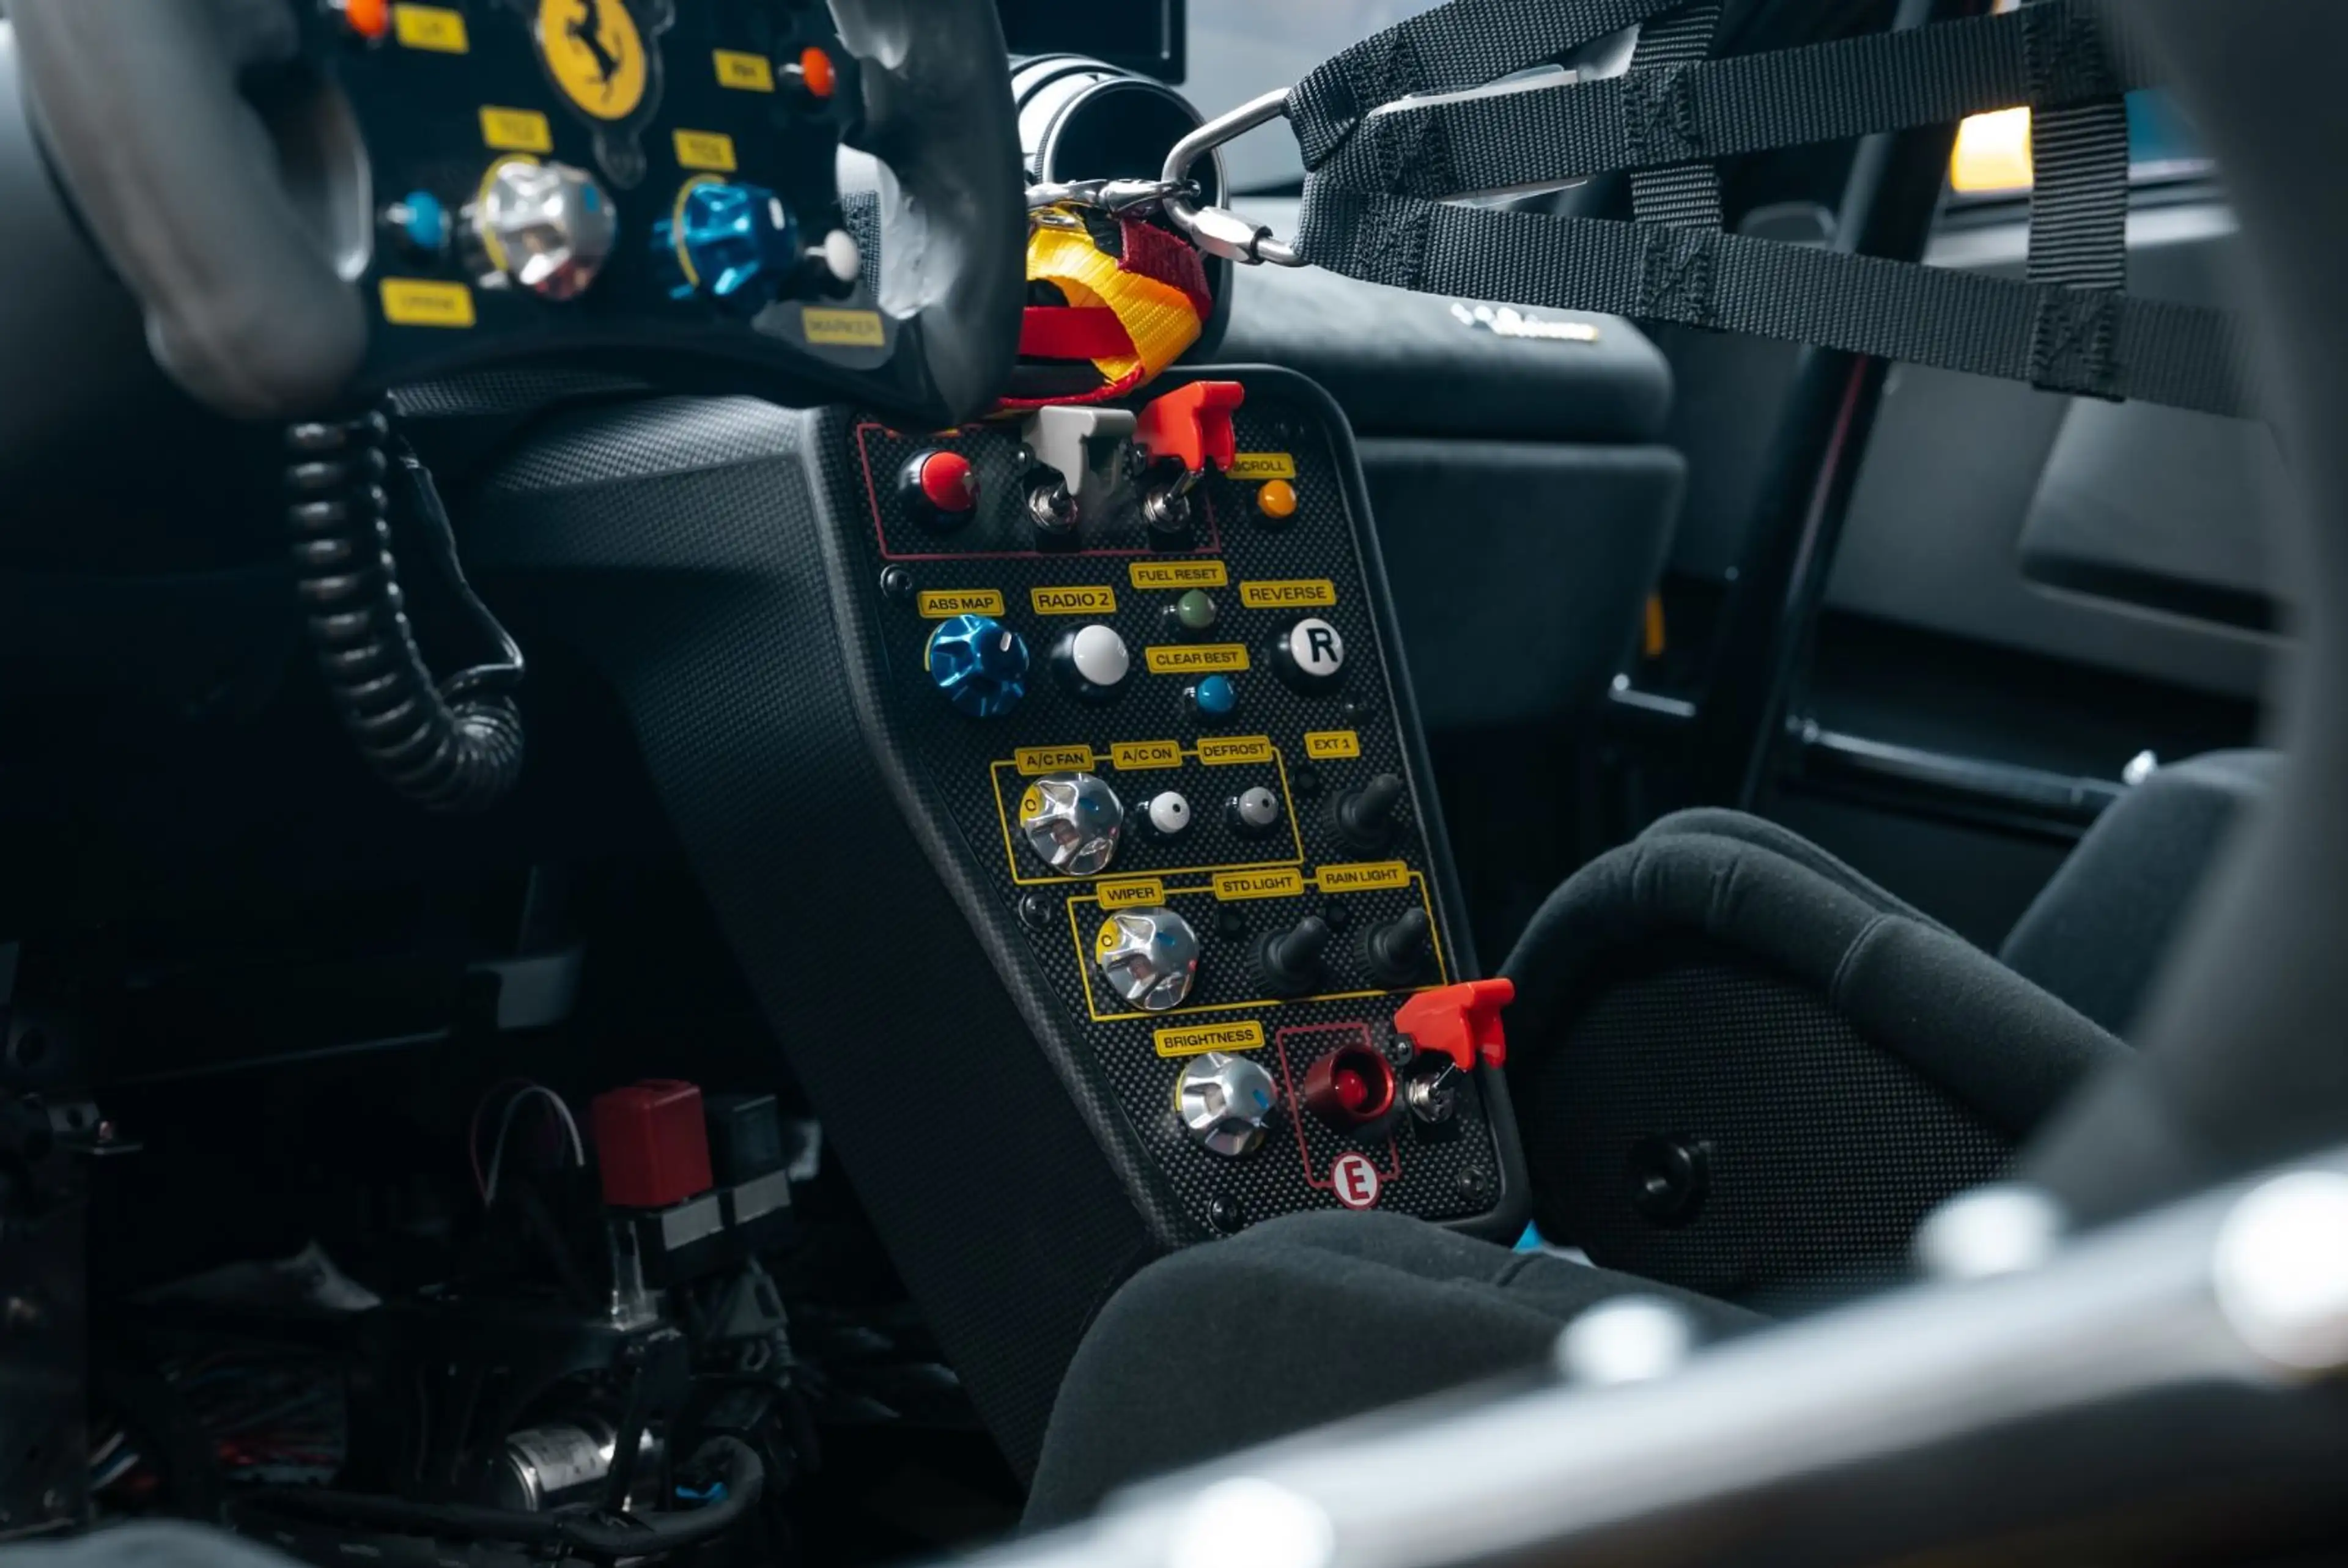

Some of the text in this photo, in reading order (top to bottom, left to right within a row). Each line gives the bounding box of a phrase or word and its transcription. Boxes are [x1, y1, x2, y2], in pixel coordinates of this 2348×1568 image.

[1138, 568, 1219, 581] FUEL RESET
[1038, 592, 1110, 608] RADIO 2
[1249, 586, 1327, 601] REVERSE
[928, 597, 994, 610] ABS MAP
[1305, 627, 1338, 663] R
[1156, 651, 1239, 666] CLEAR BEST
[1203, 743, 1266, 757] DEFROST
[1313, 738, 1351, 751] EXT 1
[1027, 753, 1085, 768] A/C FAN
[1122, 748, 1173, 764] A/C ON
[1326, 868, 1398, 885] RAIN LIGHT
[1223, 877, 1293, 892] STD LIGHT
[1106, 887, 1155, 901] WIPER
[1164, 1029, 1255, 1048] BRIGHTNESS
[1343, 1160, 1370, 1201] E
